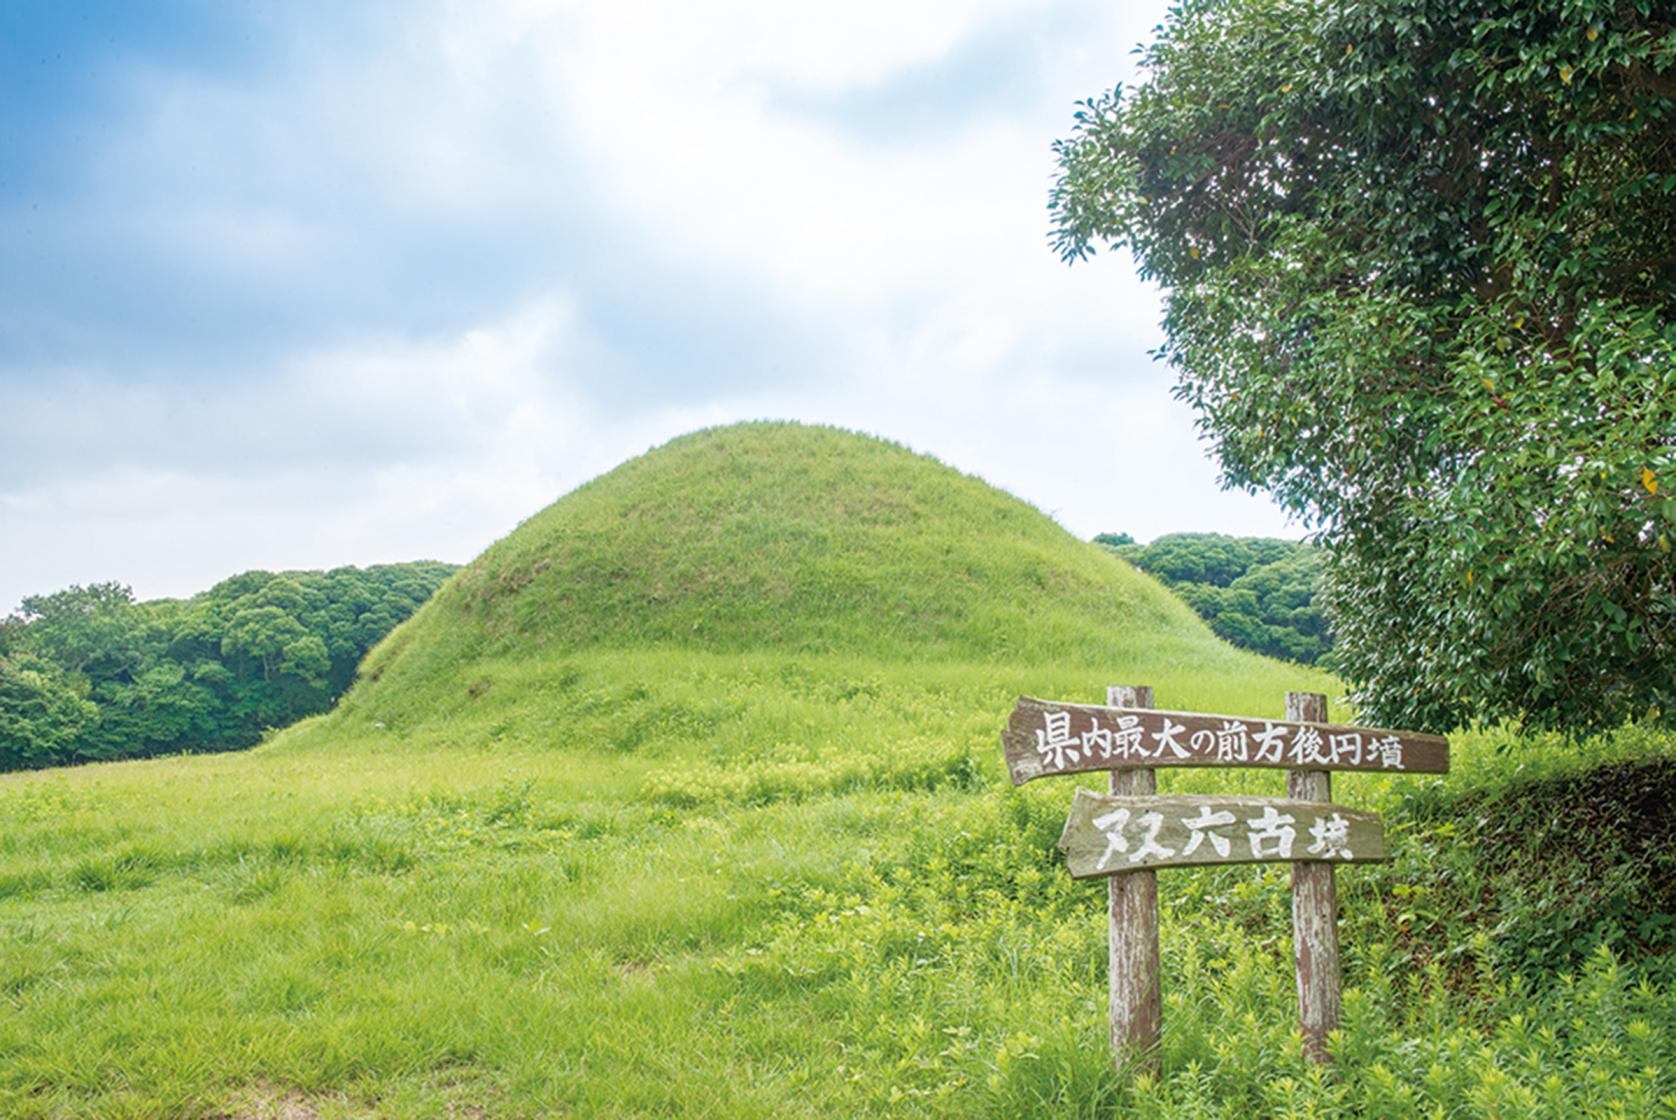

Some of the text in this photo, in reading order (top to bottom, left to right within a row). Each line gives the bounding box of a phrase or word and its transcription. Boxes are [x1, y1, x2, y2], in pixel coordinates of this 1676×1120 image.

[1036, 711, 1405, 769] 県内最大の前方後円墳
[1092, 806, 1354, 869] 双六古墳
